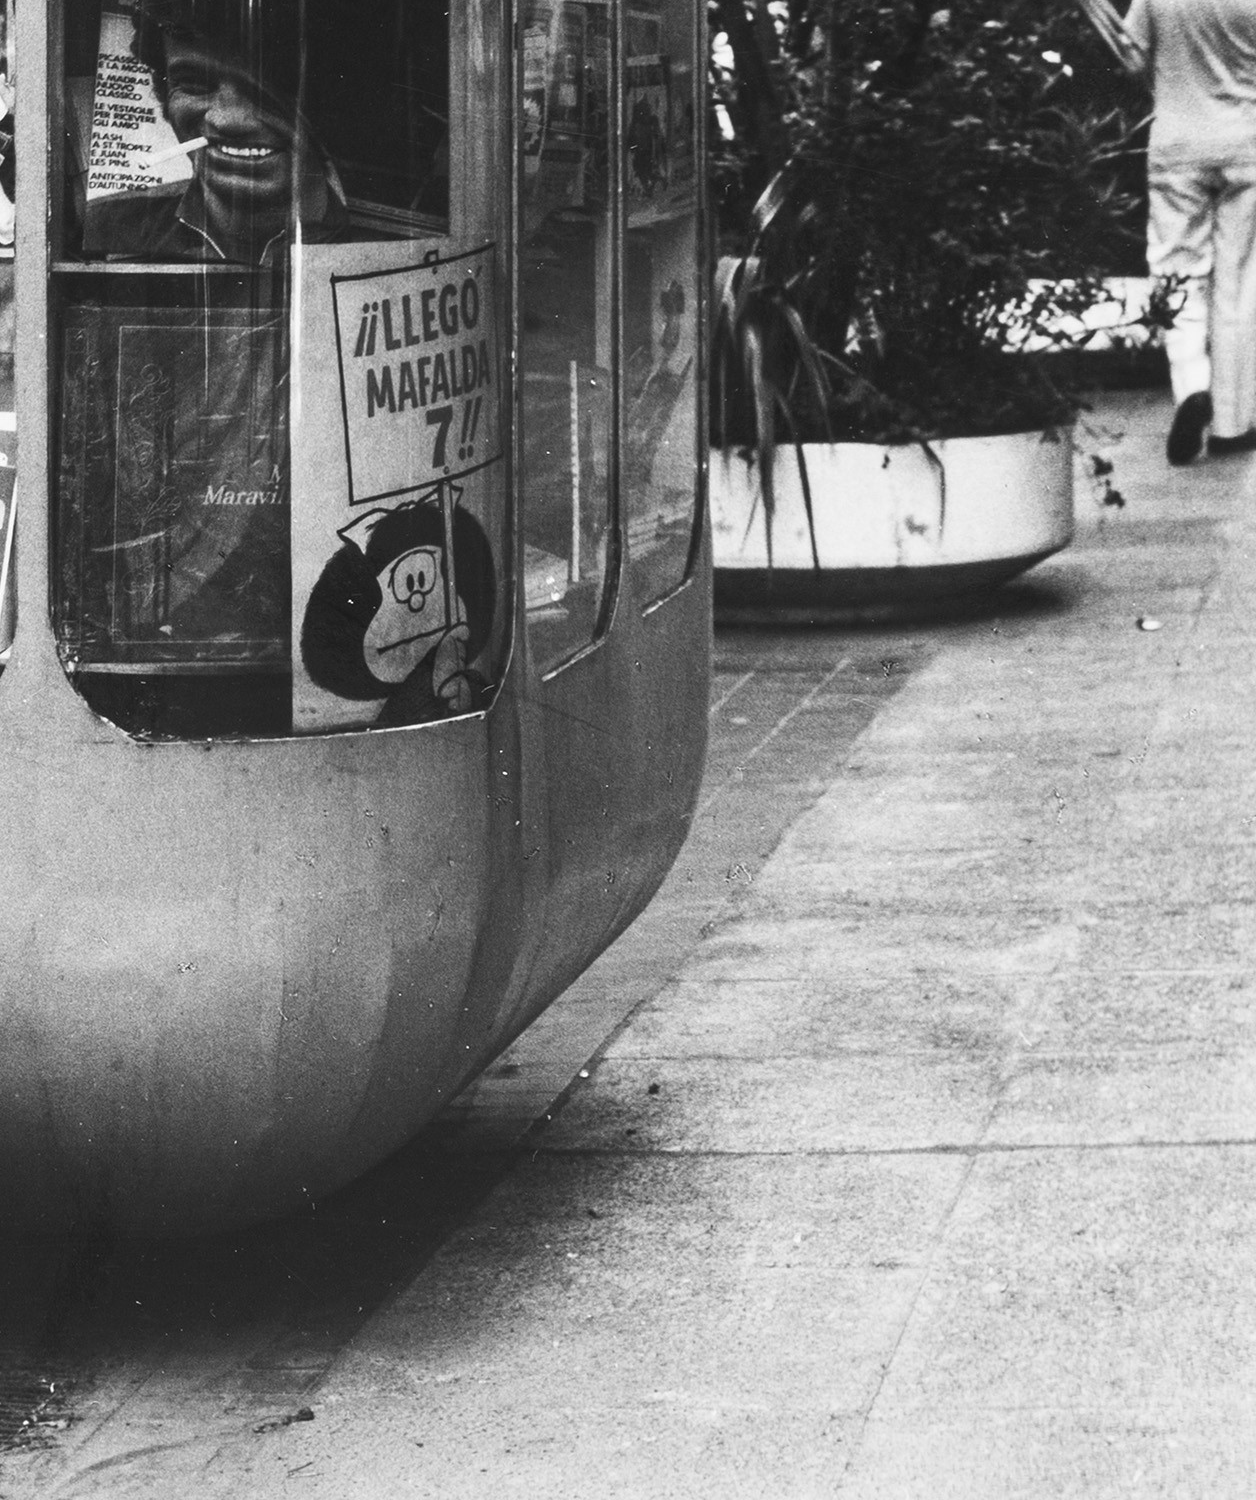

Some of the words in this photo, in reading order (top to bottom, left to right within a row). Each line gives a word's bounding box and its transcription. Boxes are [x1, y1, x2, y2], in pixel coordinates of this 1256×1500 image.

[107, 74, 150, 86] MADRAS
[96, 81, 135, 92] NUOVO
[96, 88, 143, 101] CLASSICO
[94, 111, 110, 119] PER
[92, 132, 123, 141] FLASH
[116, 142, 153, 154] TROPEZ
[99, 150, 127, 159] JUAN
[90, 158, 106, 167] LES
[108, 159, 131, 168] PINS
[90, 172, 163, 184] ANTICIPAZIONI
[367, 339, 491, 419] MAFALDA
